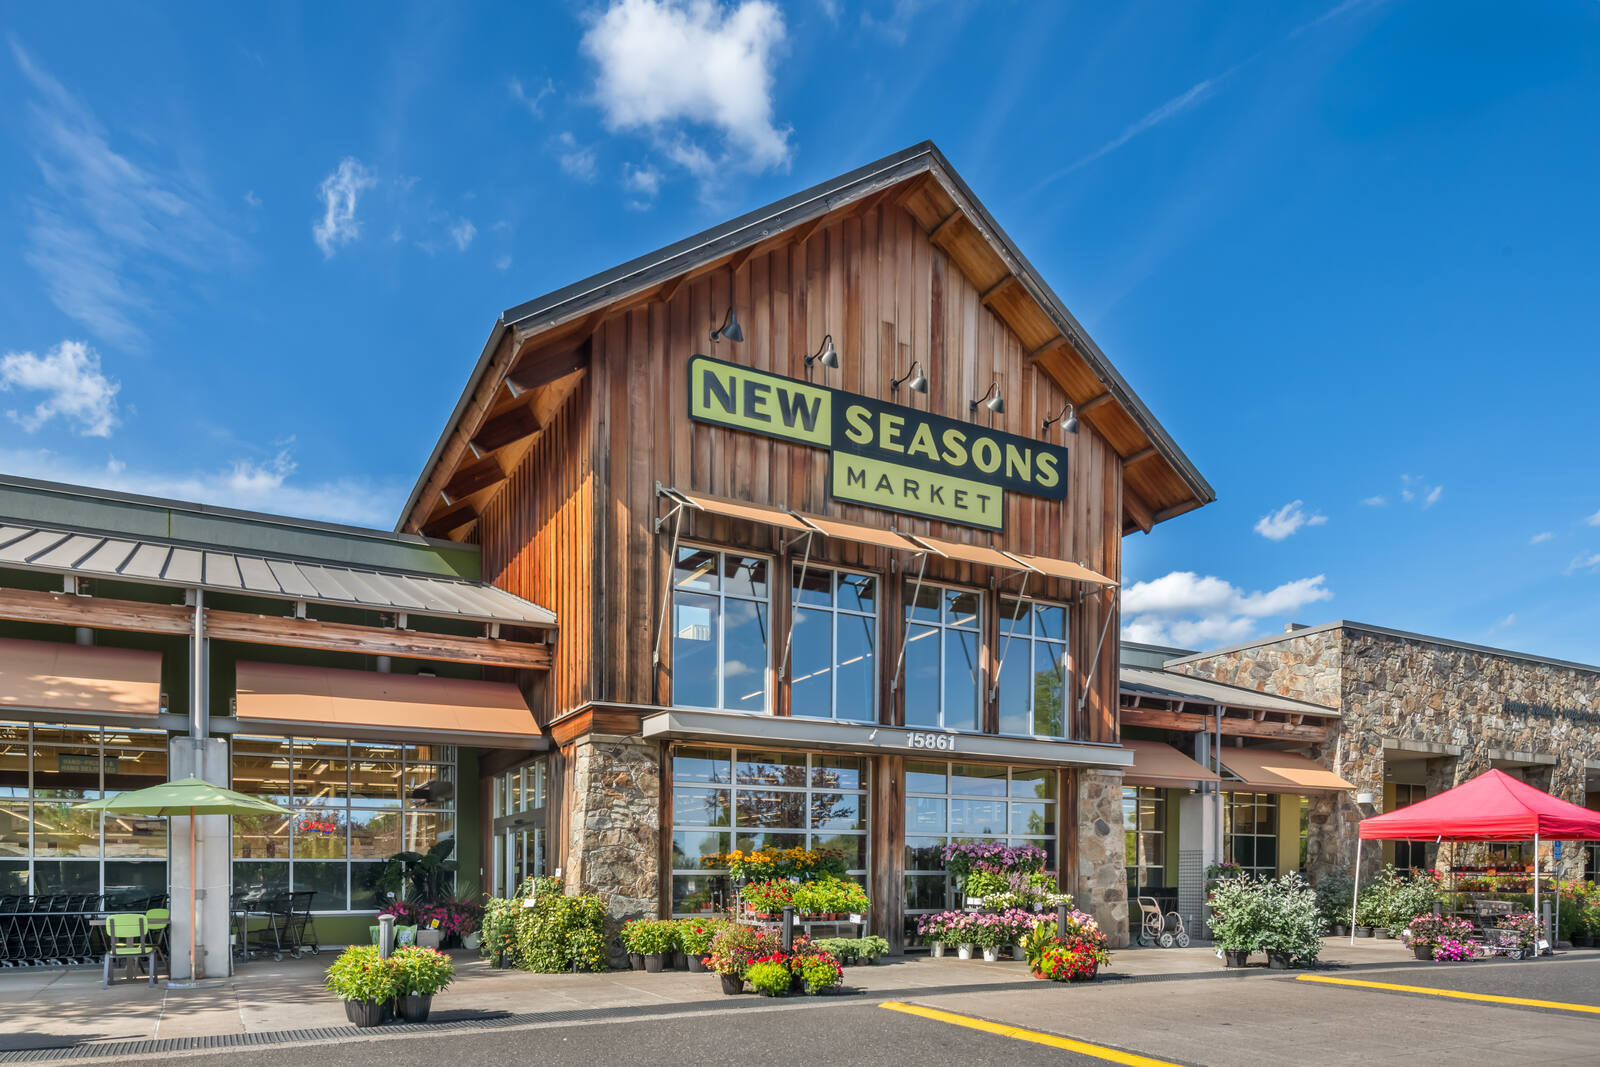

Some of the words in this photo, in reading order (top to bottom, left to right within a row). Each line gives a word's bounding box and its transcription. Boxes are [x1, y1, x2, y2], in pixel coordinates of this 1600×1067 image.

[703, 369, 822, 432] NEW
[845, 405, 1060, 488] SEASONS
[847, 466, 991, 514] MARKET
[906, 731, 955, 751] 15861
[299, 820, 335, 832] OPEN
